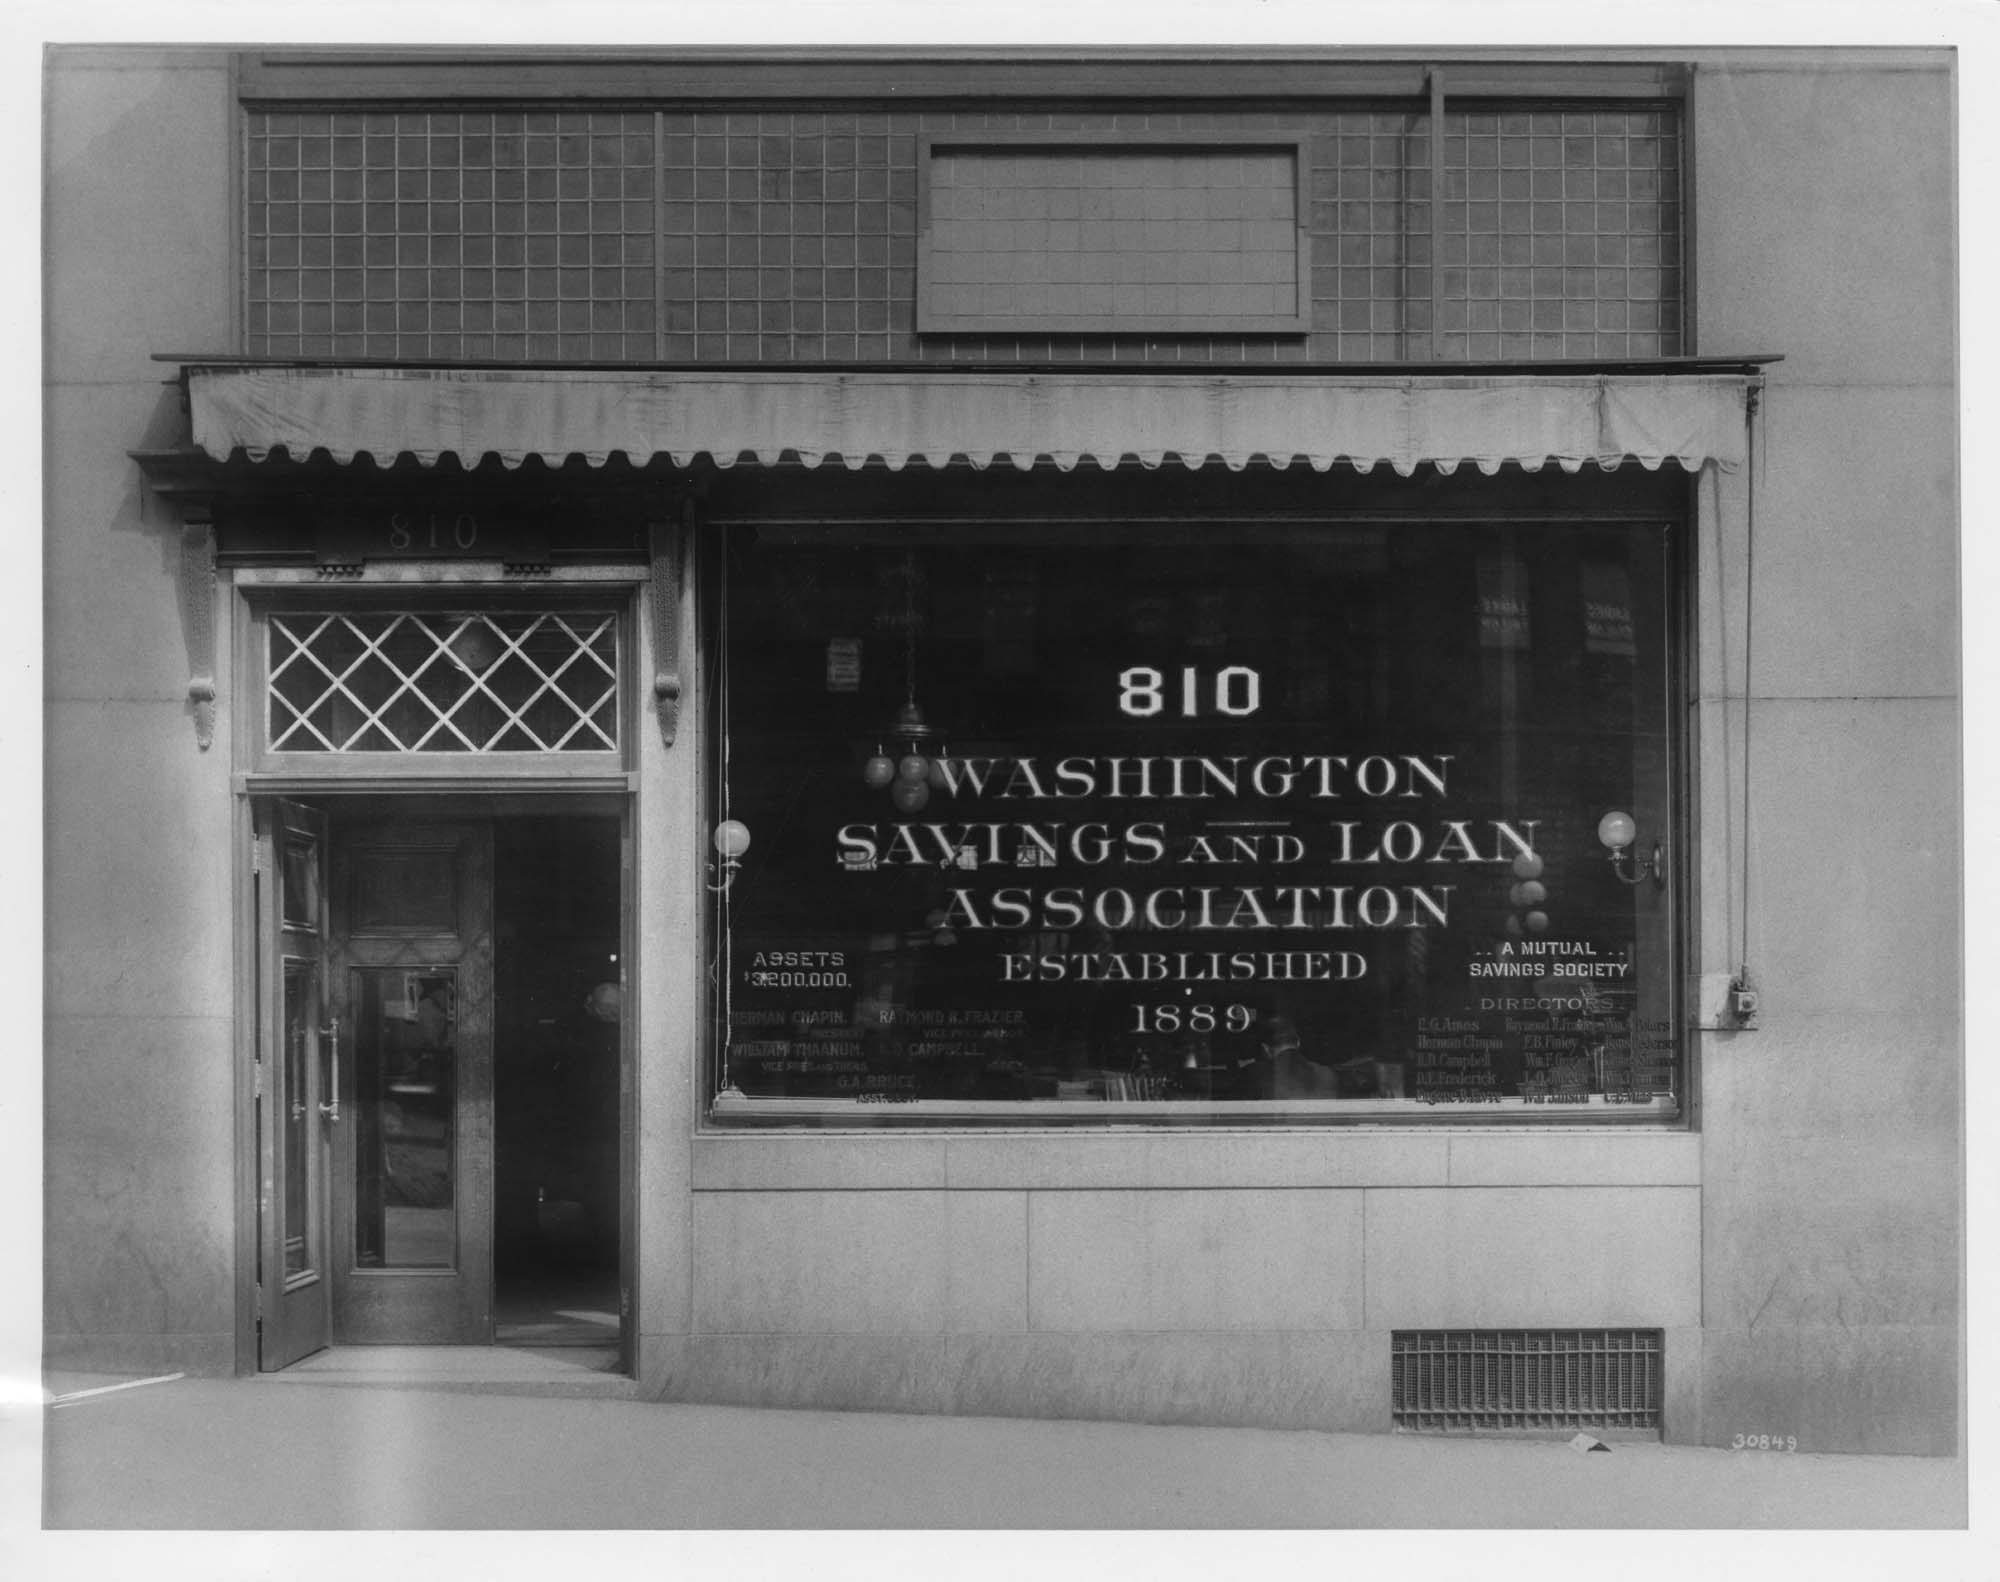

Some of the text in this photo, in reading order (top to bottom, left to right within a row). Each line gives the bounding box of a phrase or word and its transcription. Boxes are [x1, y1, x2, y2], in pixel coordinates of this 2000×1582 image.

[390, 512, 477, 550] 810
[1119, 666, 1260, 717] 810
[935, 754, 1453, 800] WASHINGTON
[836, 820, 1544, 869] SAVINGS AND LOAN
[939, 886, 1454, 930] ASSOCIATION
[752, 952, 845, 967] ASSETS
[1500, 942, 1597, 956] A MUTUAL
[1001, 951, 1369, 982] ESTABLISHED
[1469, 962, 1629, 977] SAVINGS SOCIETY
[1135, 1004, 1254, 1033] 1889
[1479, 998, 1615, 1011] DIRECTORS
